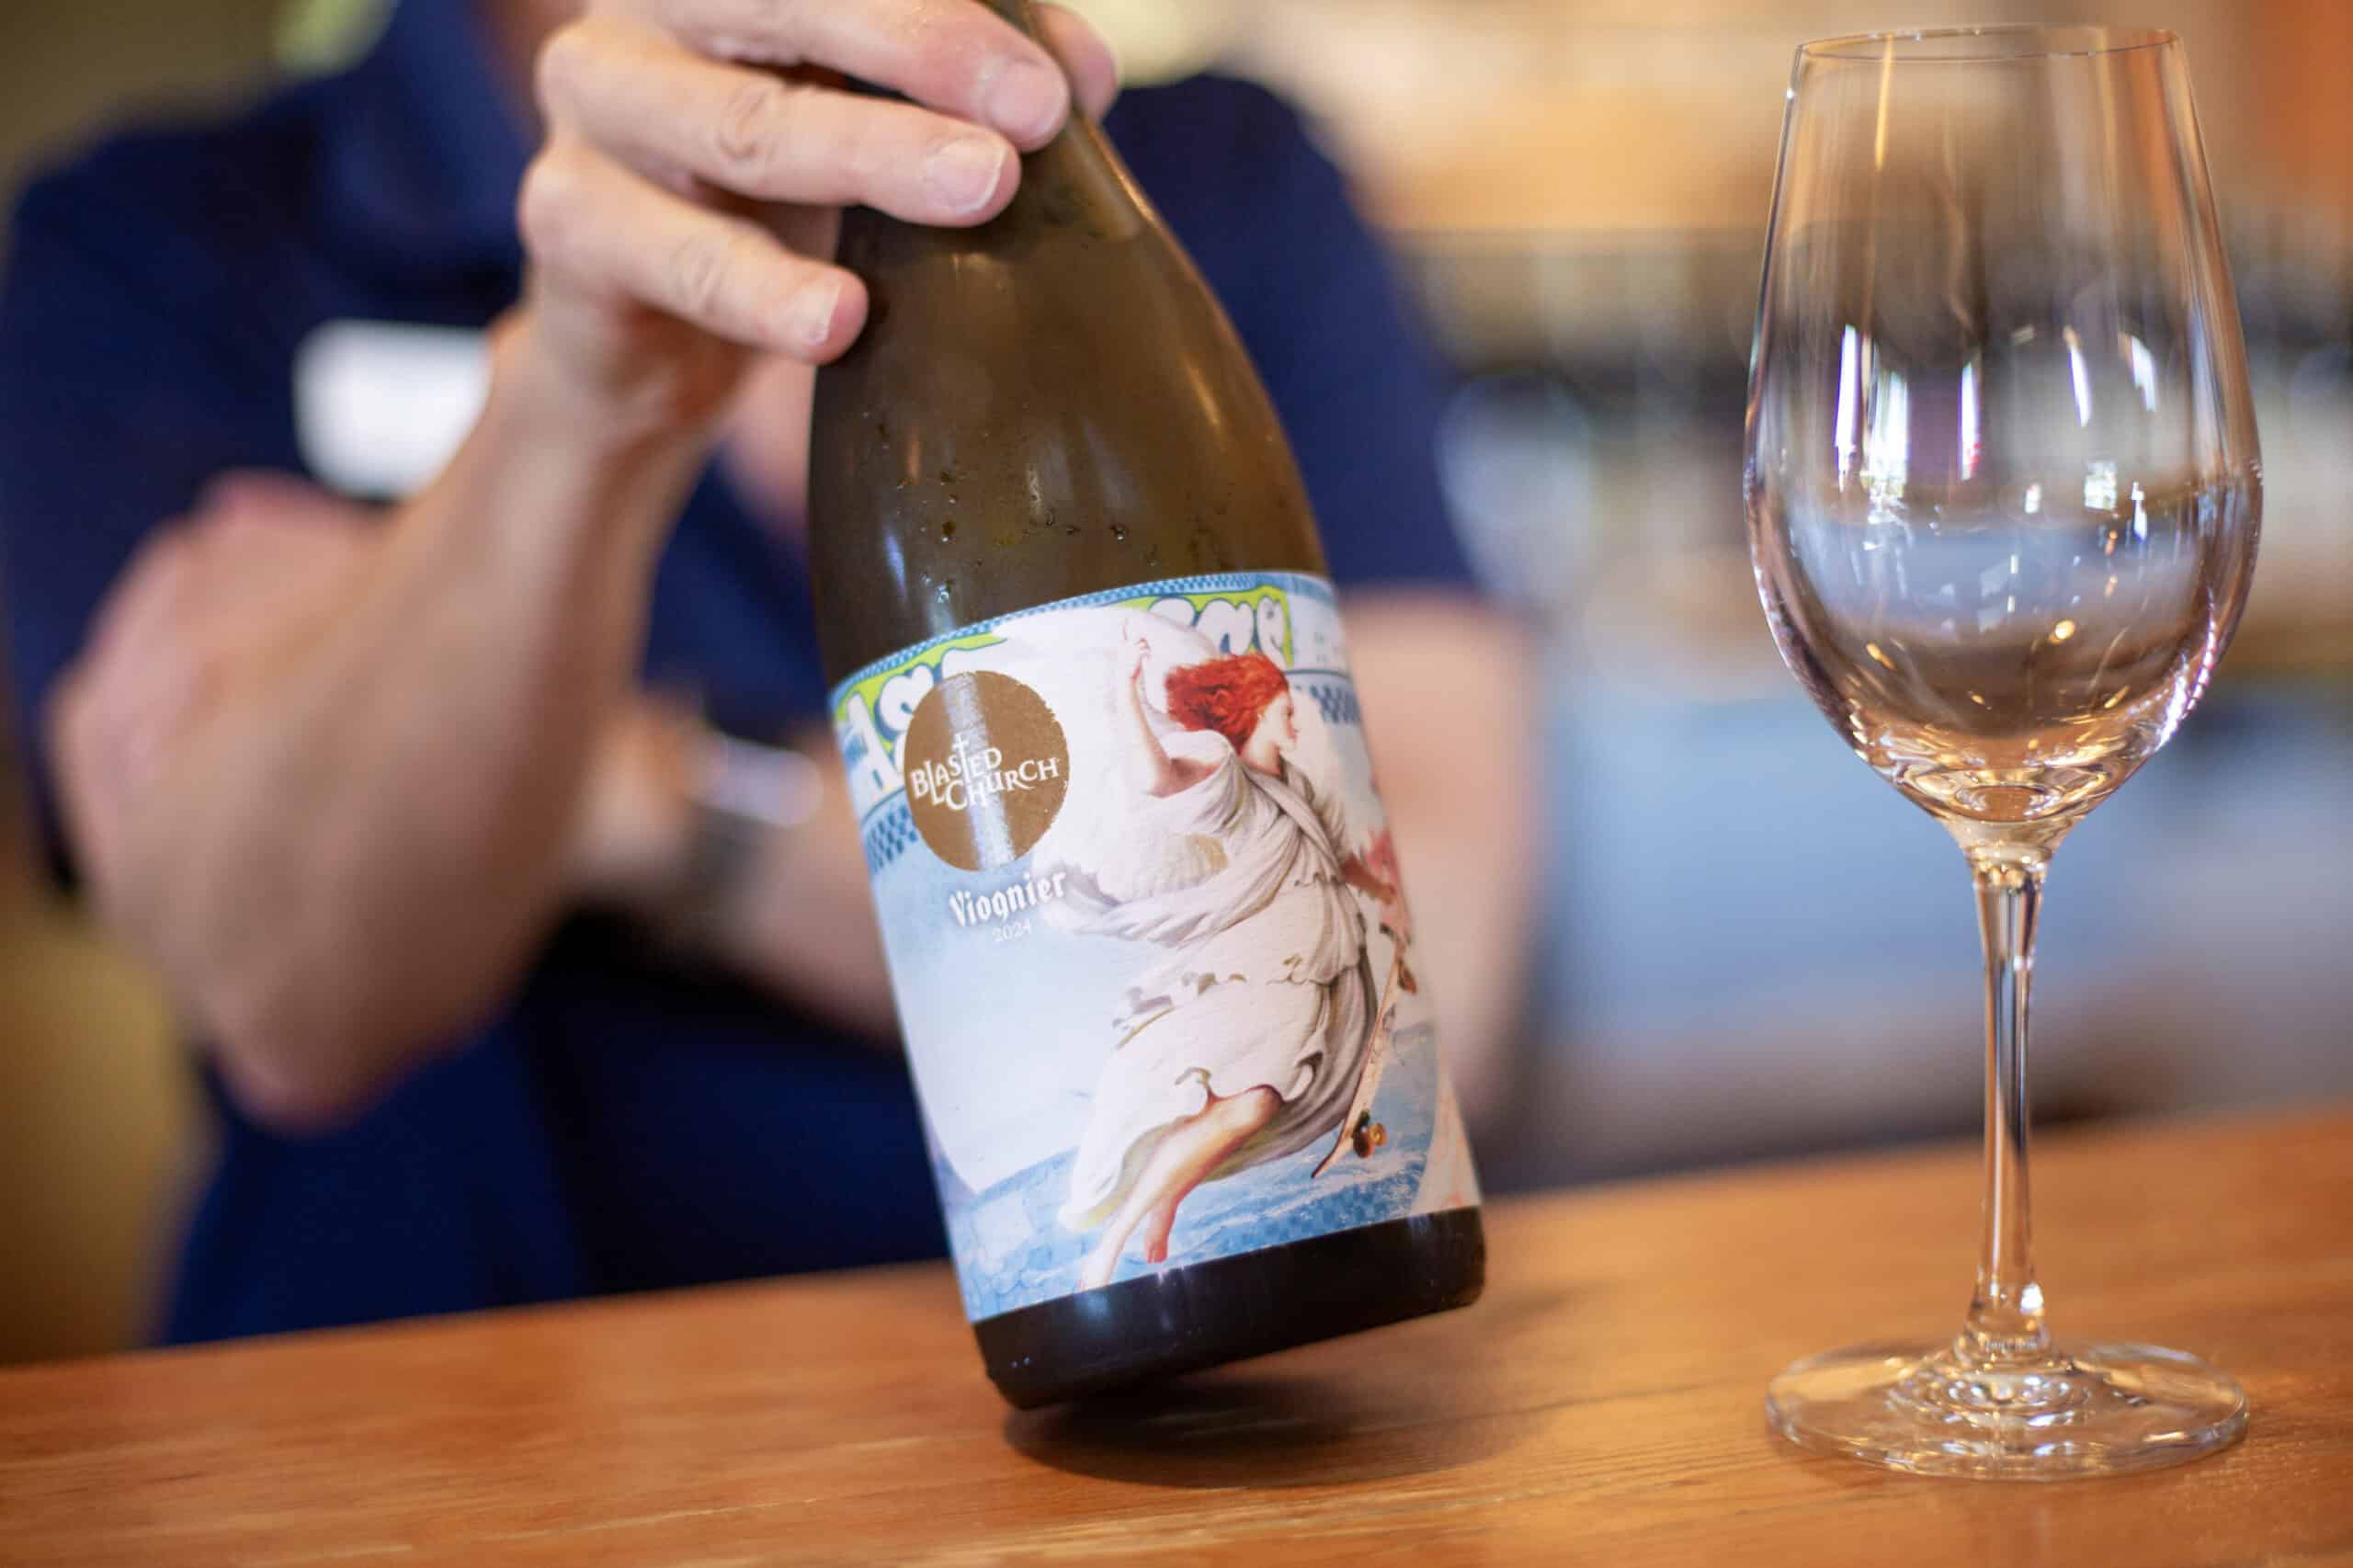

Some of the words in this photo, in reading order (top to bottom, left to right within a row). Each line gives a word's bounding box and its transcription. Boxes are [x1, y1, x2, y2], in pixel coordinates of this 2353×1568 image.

[911, 733, 1003, 806] BLASTED
[945, 757, 1060, 811] CHURCH
[949, 871, 1066, 927] Viognier
